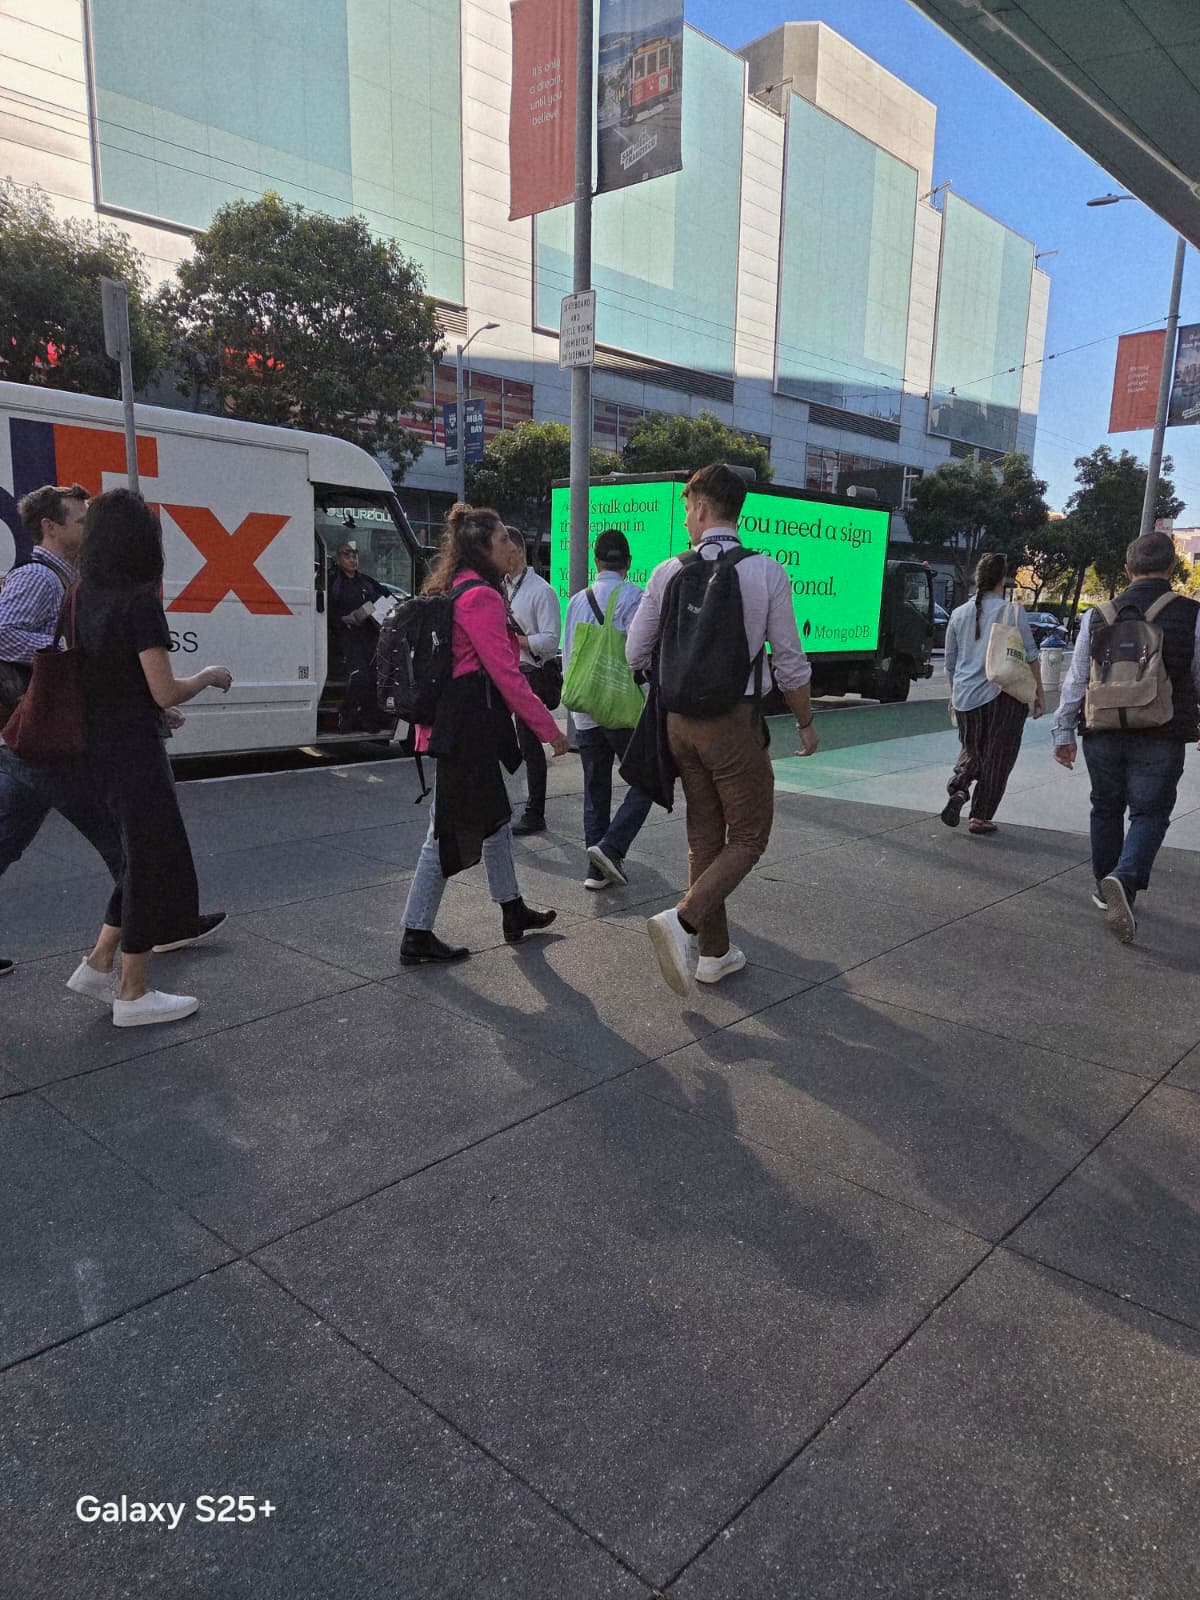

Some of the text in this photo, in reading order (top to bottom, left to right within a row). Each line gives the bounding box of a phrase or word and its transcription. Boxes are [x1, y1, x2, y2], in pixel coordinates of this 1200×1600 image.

[470, 425, 483, 434] BAY
[598, 498, 621, 514] talk
[623, 498, 659, 513] about
[633, 517, 645, 532] in
[775, 518, 822, 538] need
[825, 523, 837, 540] a
[839, 522, 873, 549] sign
[775, 549, 801, 567] on
[814, 625, 871, 642] MongoDB
